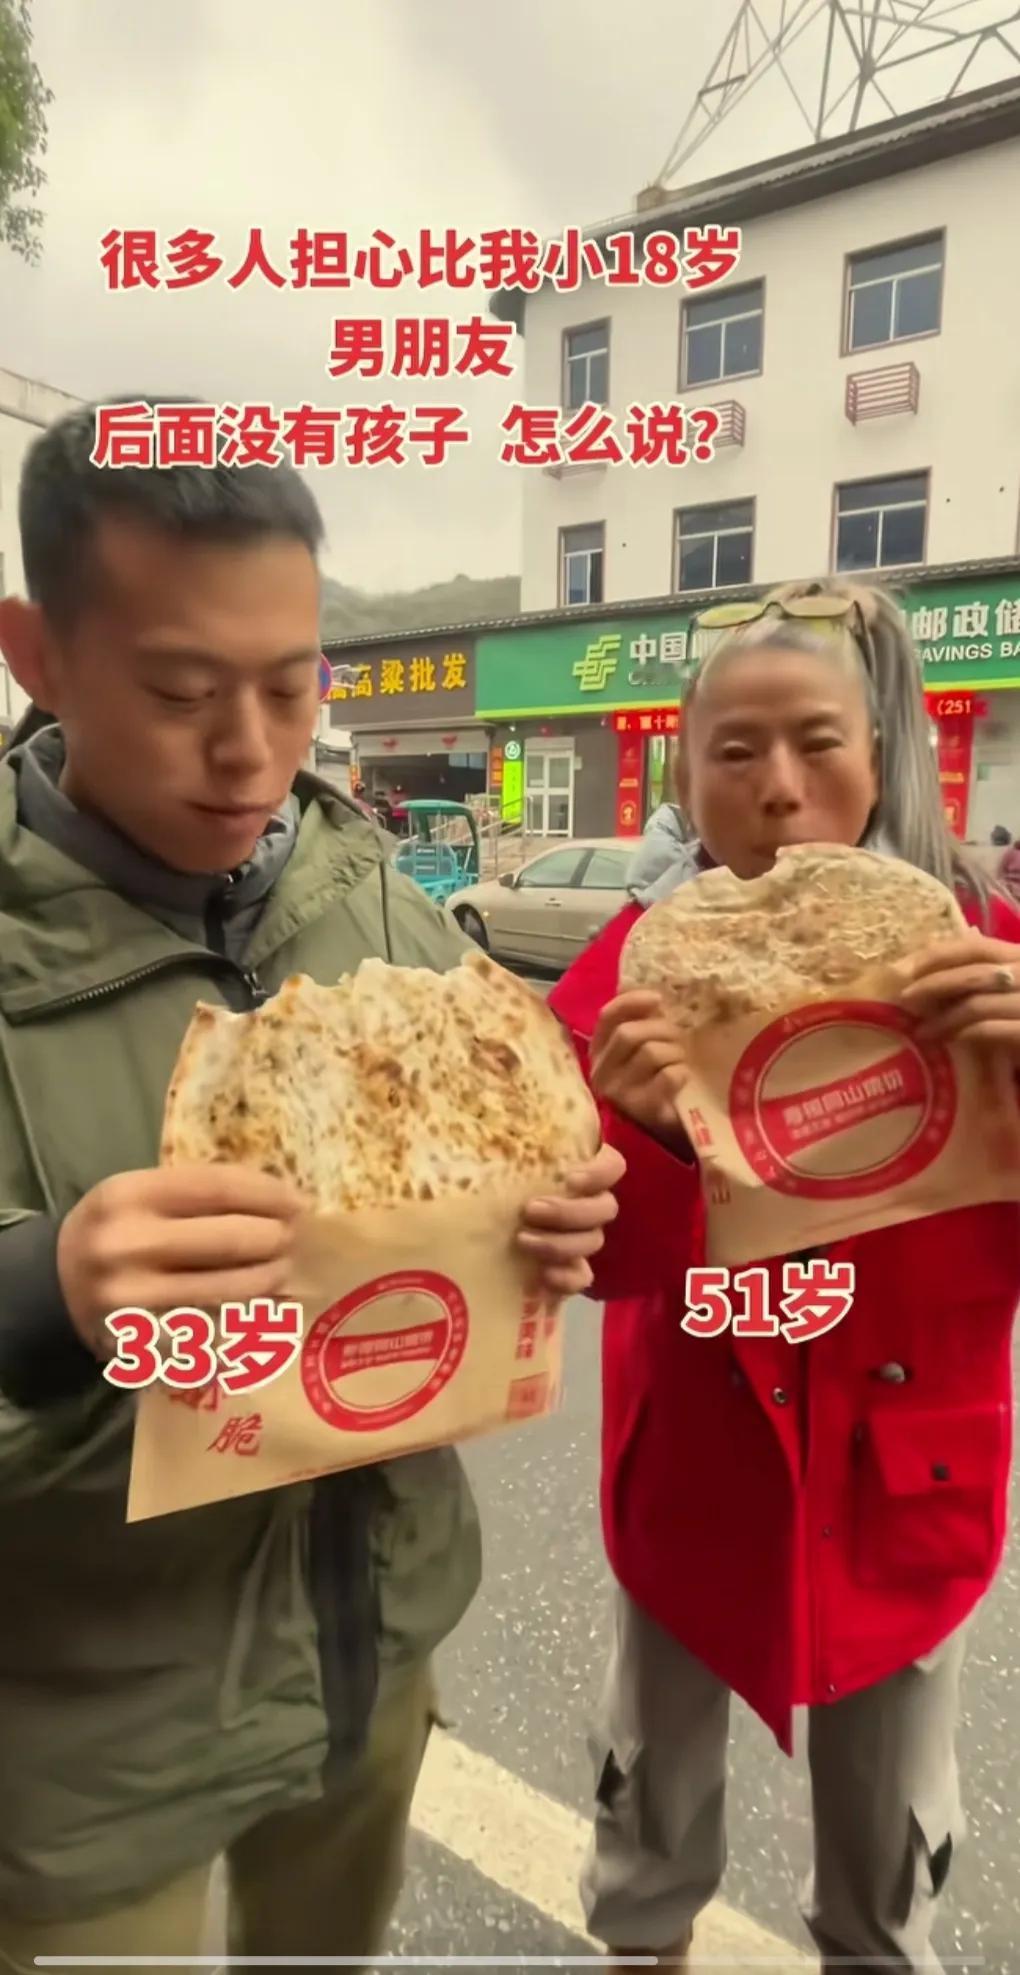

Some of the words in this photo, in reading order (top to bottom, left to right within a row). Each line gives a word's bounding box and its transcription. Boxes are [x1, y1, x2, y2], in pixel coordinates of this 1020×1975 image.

[899, 598, 1020, 641] 邮政储
[629, 631, 701, 665] 中国
